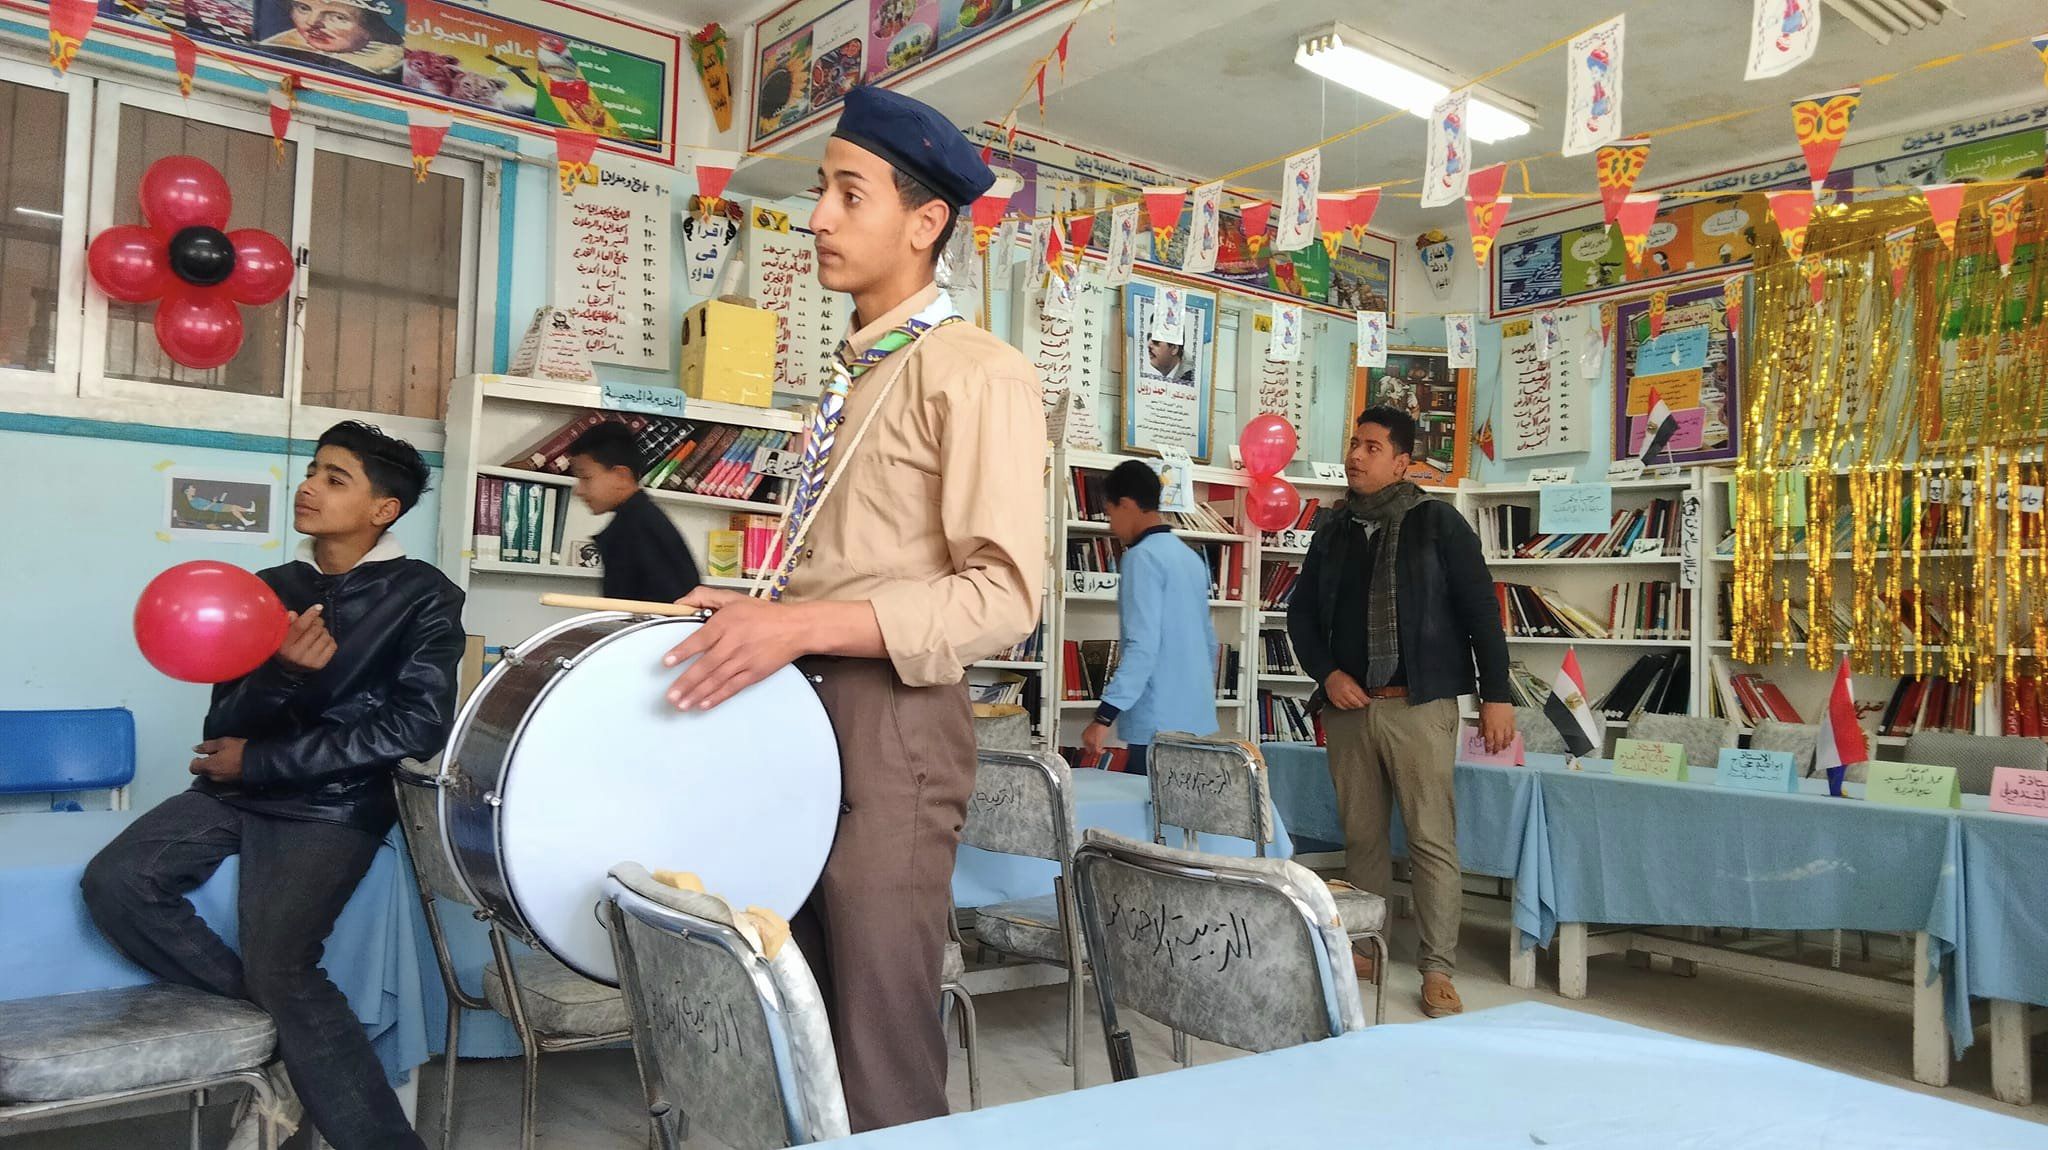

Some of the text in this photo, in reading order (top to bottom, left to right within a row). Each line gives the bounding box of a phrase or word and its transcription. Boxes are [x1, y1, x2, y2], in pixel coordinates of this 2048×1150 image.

[404, 18, 488, 48] الحيوان
[493, 40, 536, 59] عالم
[1952, 107, 2048, 142] لإعدادية
[1998, 149, 2040, 168] جسم
[1088, 576, 1118, 593] لشعراء
